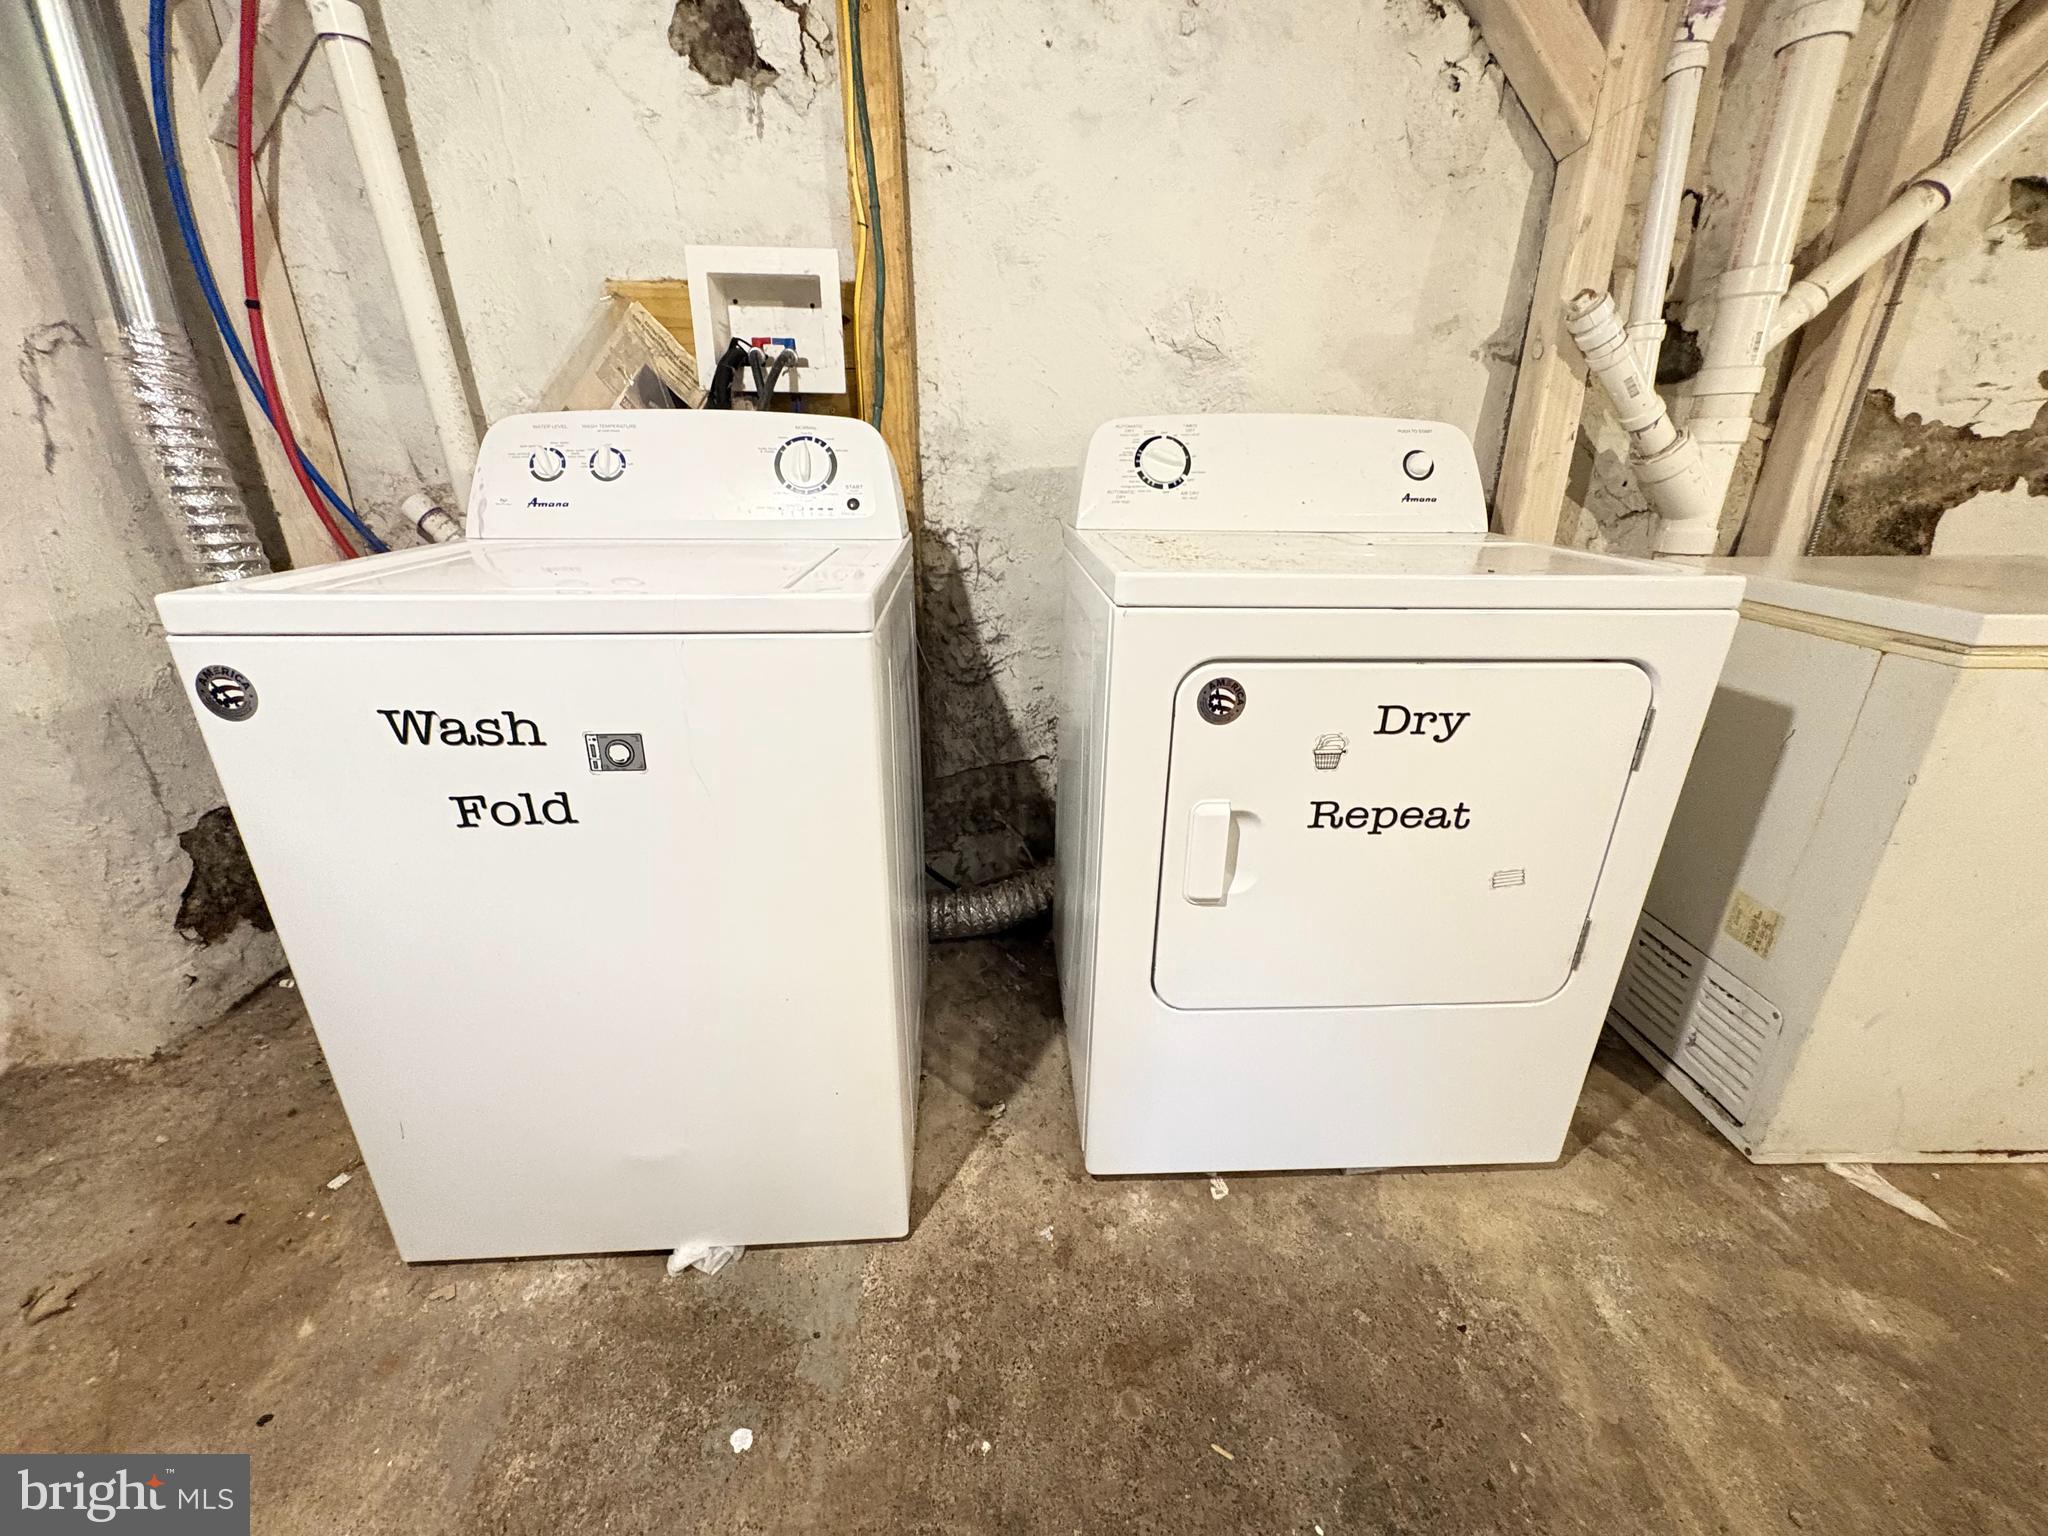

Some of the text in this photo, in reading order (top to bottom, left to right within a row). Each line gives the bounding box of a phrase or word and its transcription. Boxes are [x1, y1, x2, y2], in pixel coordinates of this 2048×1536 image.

[527, 497, 569, 508] Amana
[1401, 492, 1437, 503] Amana
[199, 666, 250, 691] AMERICA
[376, 709, 548, 747] Wash
[1373, 704, 1471, 743] Dry
[448, 792, 579, 828] Fold
[1307, 801, 1470, 835] Repeat
